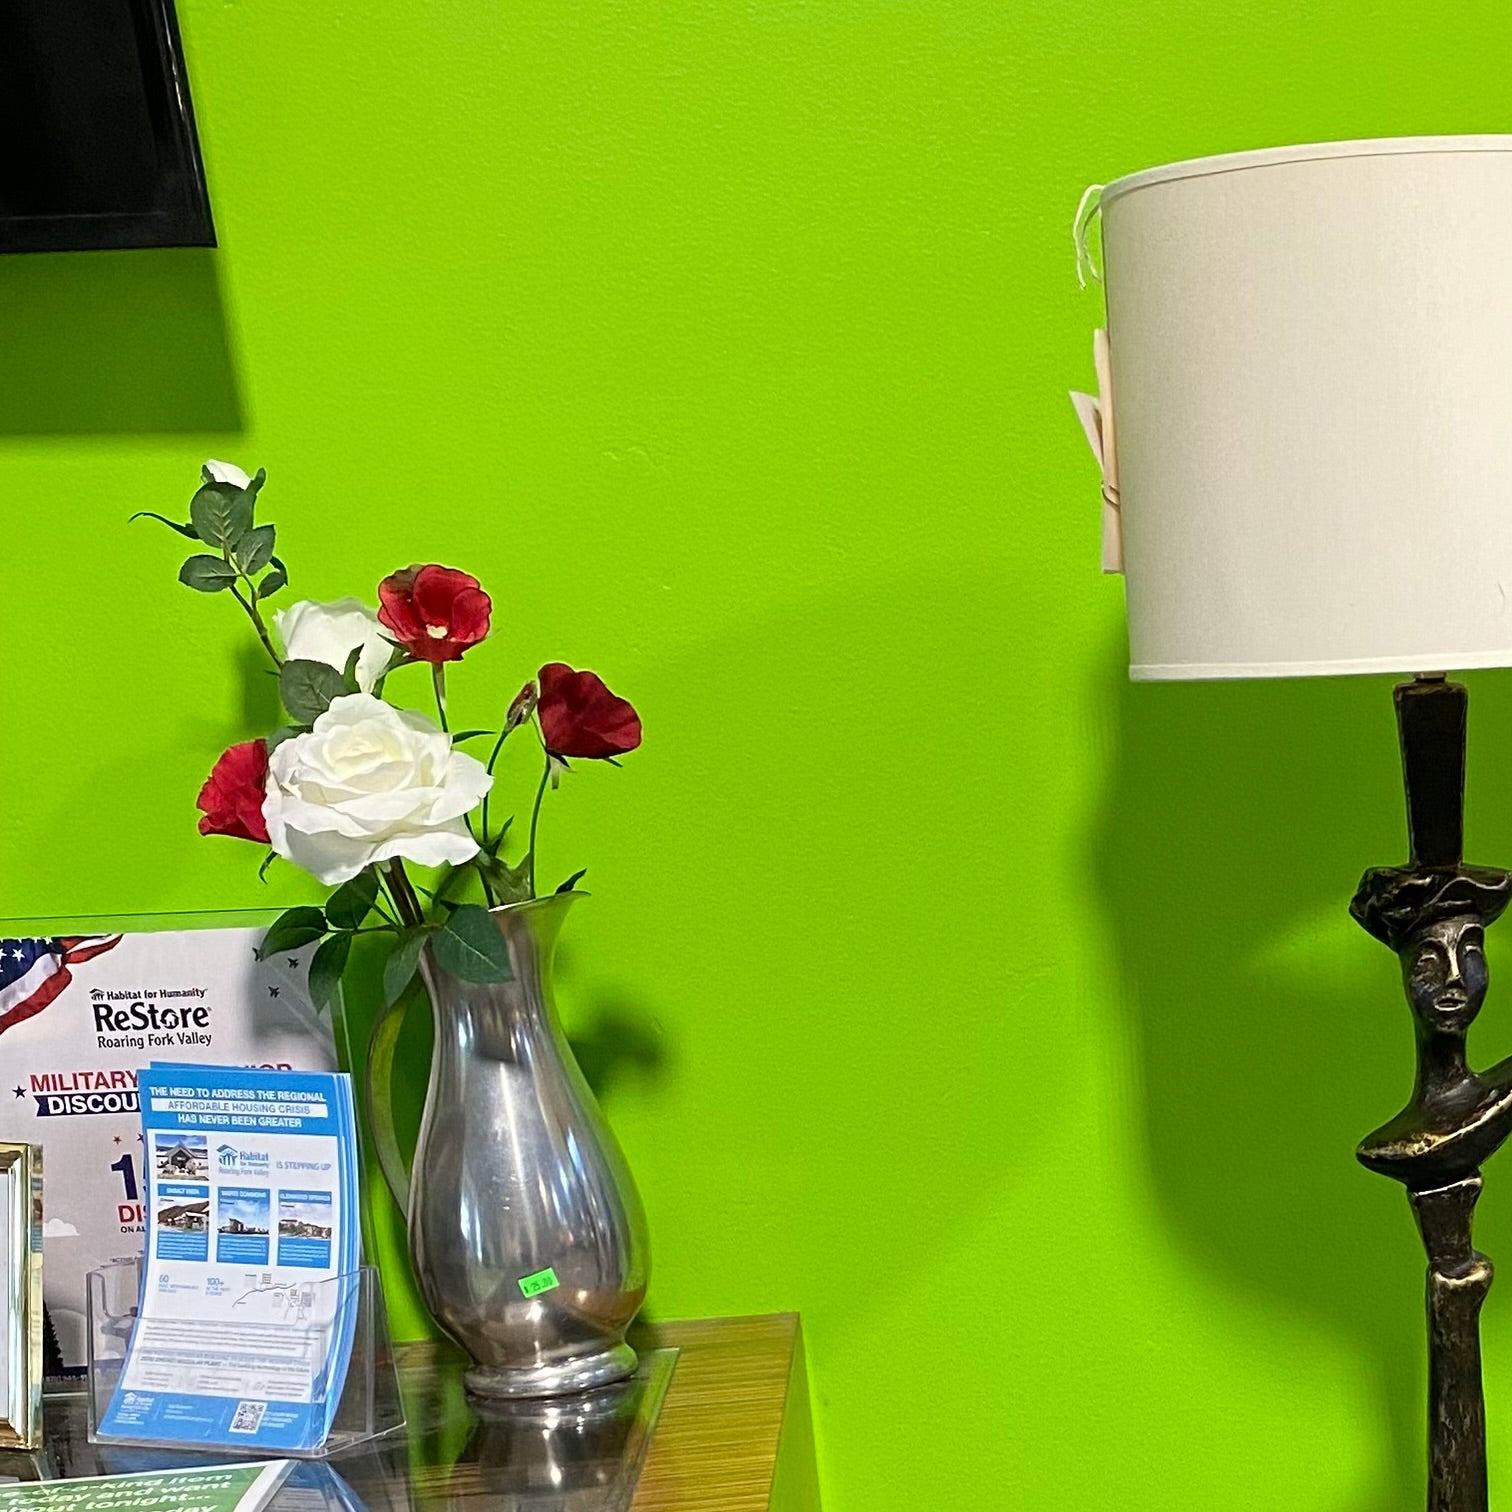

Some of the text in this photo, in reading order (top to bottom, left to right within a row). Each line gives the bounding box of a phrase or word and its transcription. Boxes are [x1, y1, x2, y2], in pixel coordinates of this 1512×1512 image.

[106, 988, 206, 1001] Habitat for Humanity
[92, 1001, 210, 1032] ReStore
[97, 1031, 212, 1050] Roaring Fork Valley
[30, 1070, 138, 1093] MILITARY
[148, 1086, 327, 1102] THE NEED TO ADDRESS THE REGIONAL
[49, 1093, 141, 1114] DISCOU
[168, 1100, 311, 1114] AFFORDABLE HOUSING CRISIS
[177, 1113, 303, 1128] HAS NEVER BEEN GREATER
[239, 1151, 269, 1161] Habitat
[276, 1161, 283, 1169] IS
[320, 1163, 332, 1171] UP
[0, 1474, 233, 1498] e-of-a-kind item
[8, 1481, 232, 1505] today and want
